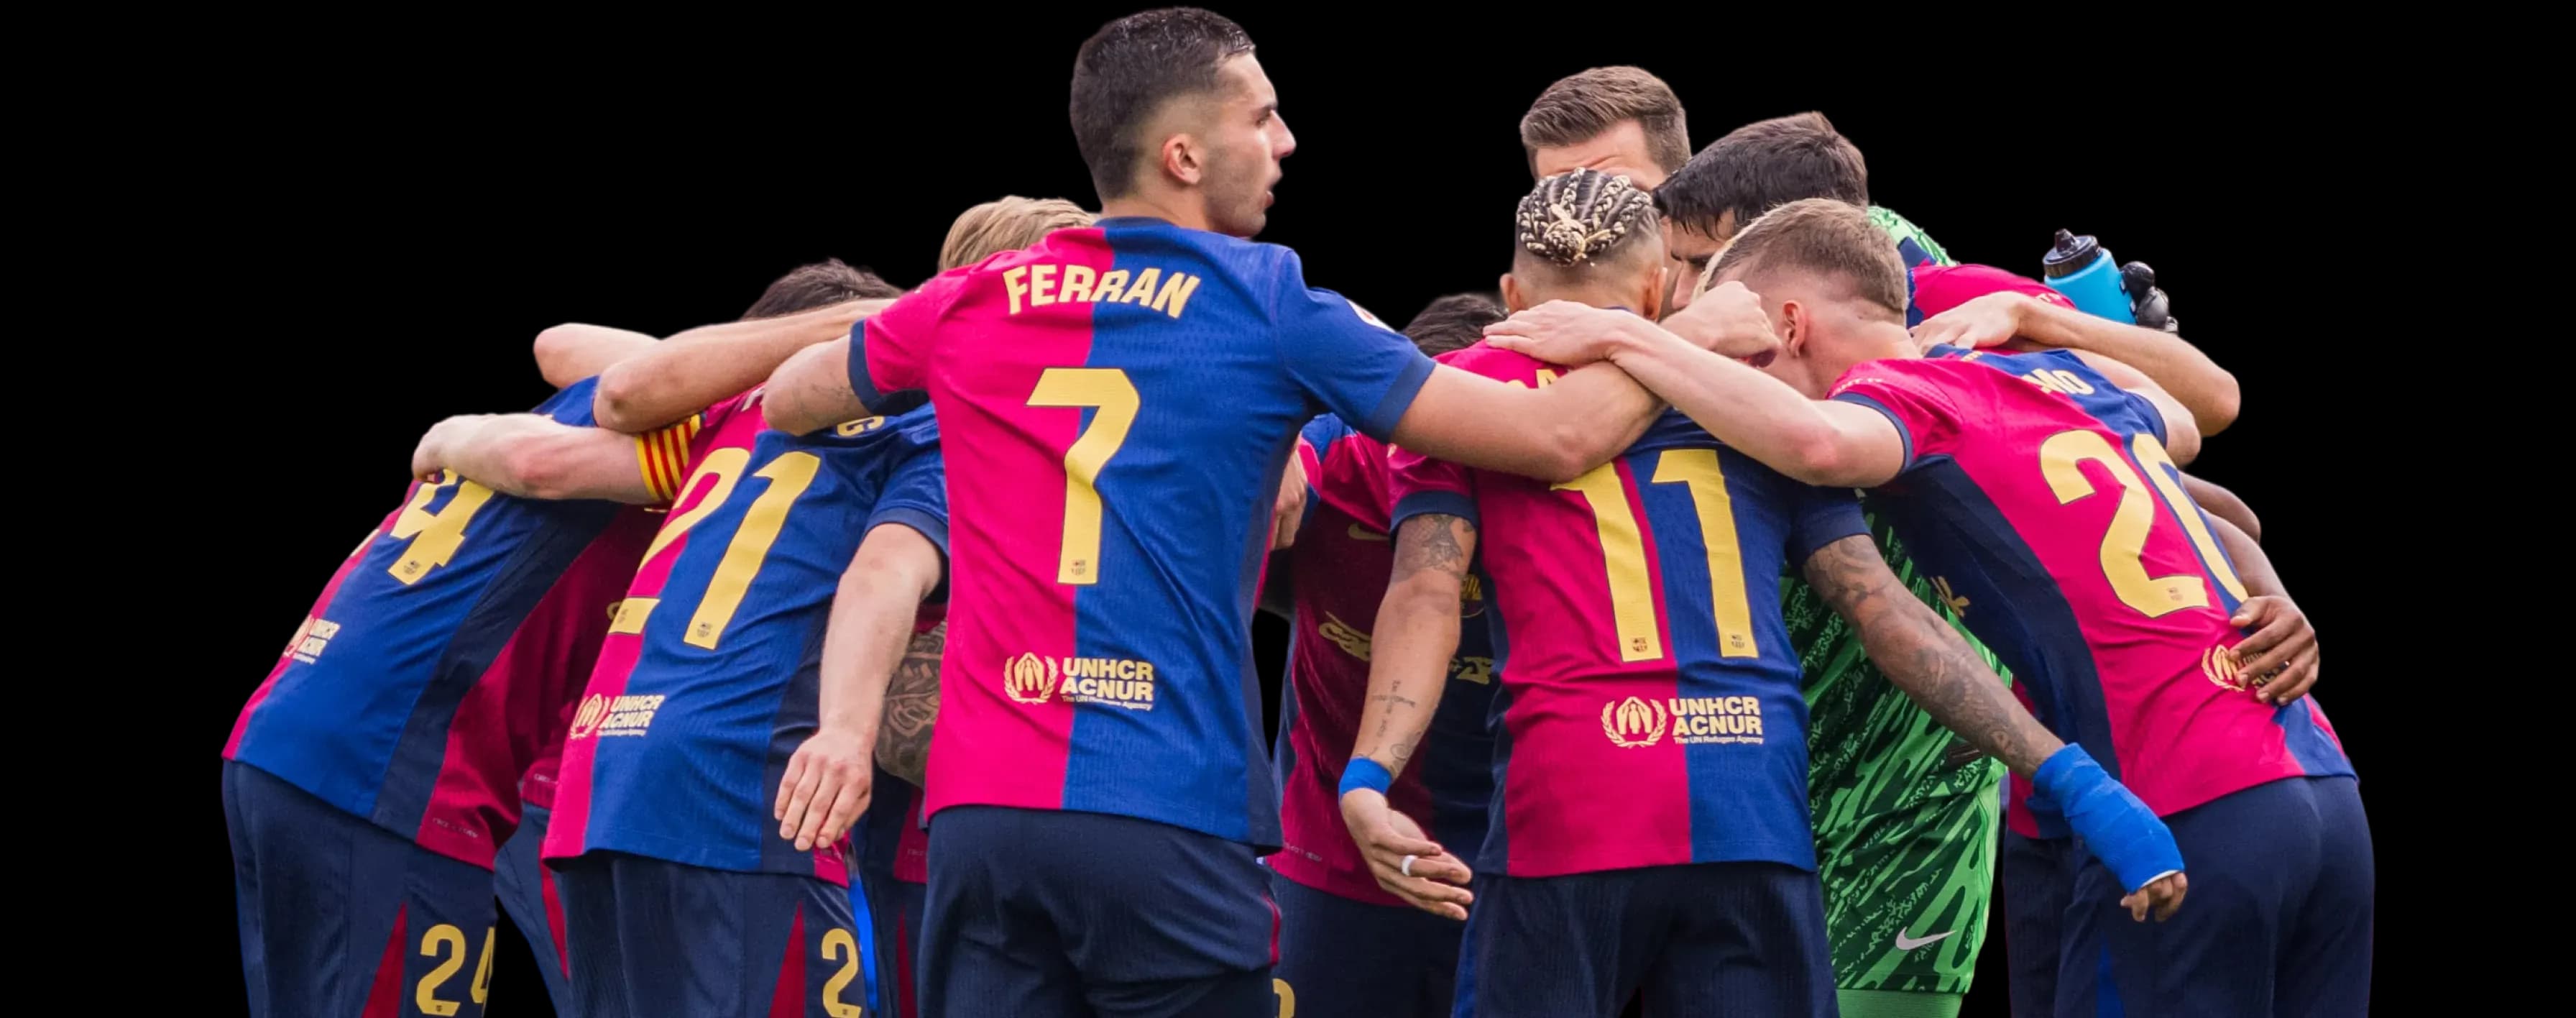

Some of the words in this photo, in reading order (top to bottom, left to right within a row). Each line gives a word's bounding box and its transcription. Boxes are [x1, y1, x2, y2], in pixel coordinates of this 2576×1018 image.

[1003, 264, 1201, 318] FERRAN
[1025, 367, 1140, 584] 7
[608, 447, 821, 650] 21
[1550, 449, 1759, 662] 11
[1062, 657, 1154, 682] UNHCR
[1059, 677, 1154, 702] ACNUR
[610, 694, 666, 712] UNHCR
[1668, 697, 1760, 716] UNHCR
[598, 710, 655, 729] ACNUR
[1672, 715, 1763, 736] ACNUR
